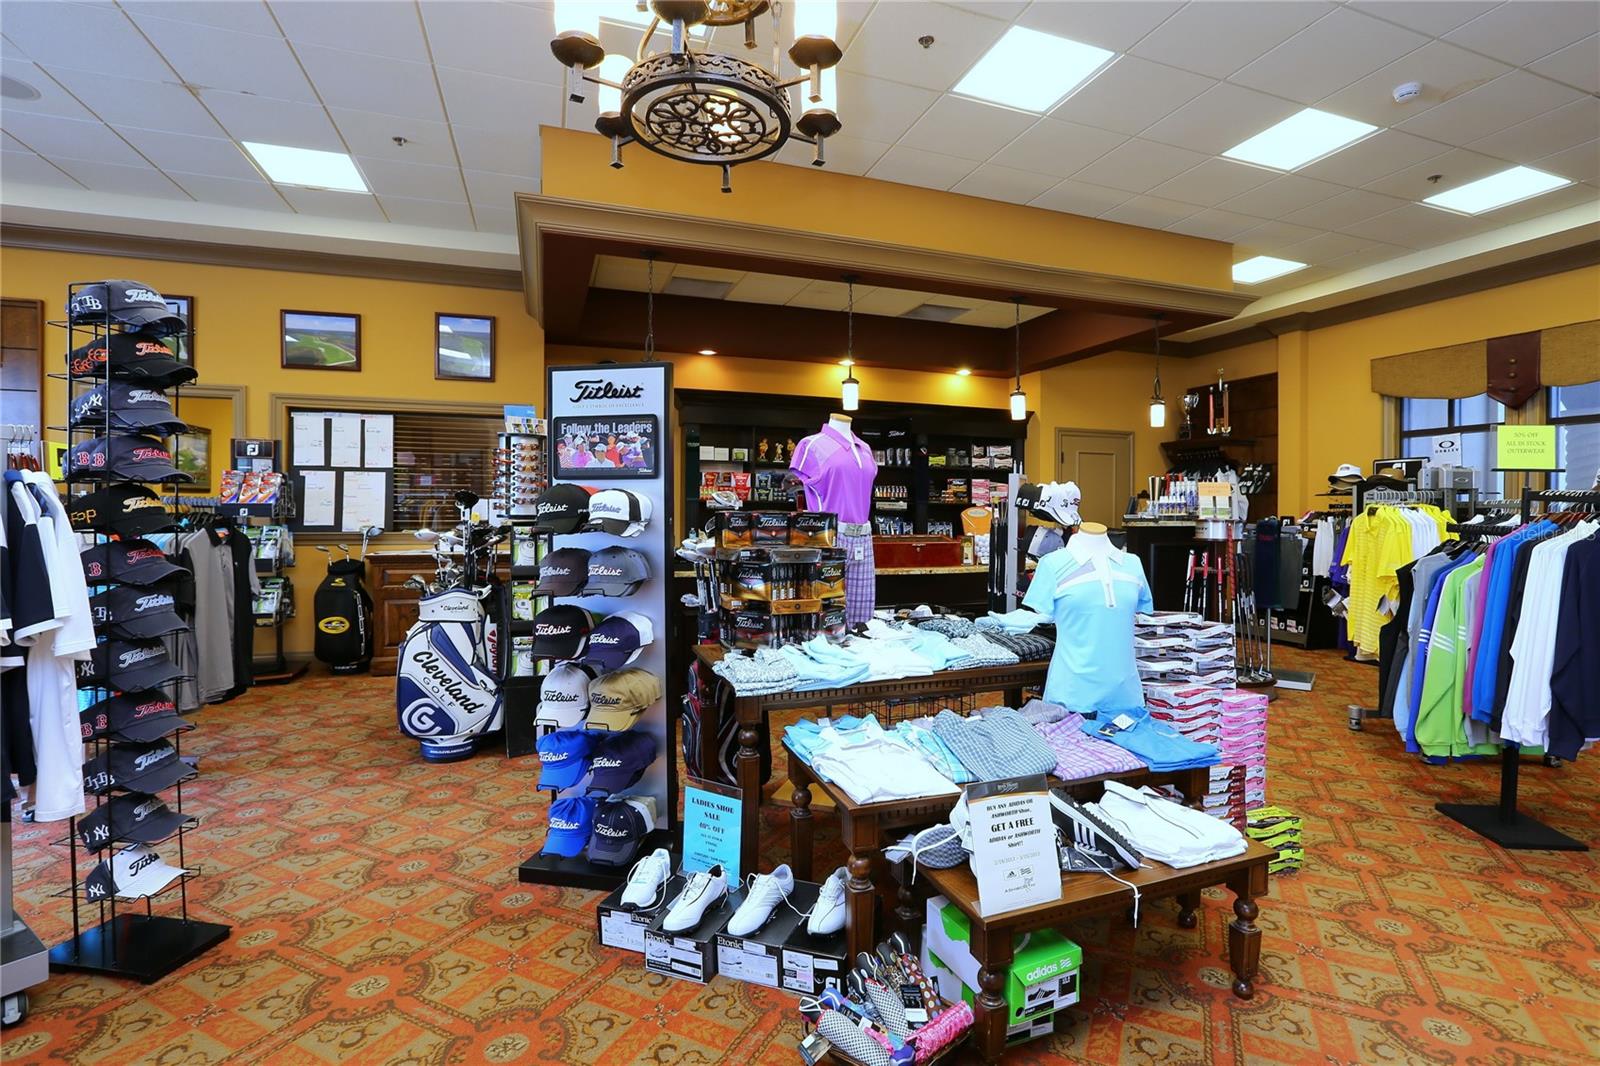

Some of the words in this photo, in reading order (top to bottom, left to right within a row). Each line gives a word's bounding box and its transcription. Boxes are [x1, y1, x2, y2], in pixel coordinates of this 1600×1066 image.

[569, 379, 644, 403] Titleist
[561, 423, 592, 434] Follow
[594, 423, 609, 434] the
[612, 422, 653, 434] Leaders
[758, 518, 787, 527] Titleist
[588, 564, 622, 576] Titleist
[535, 624, 572, 635] Titleist
[589, 633, 620, 644] Titleist
[413, 651, 485, 714] Cleveland
[422, 676, 456, 708] GOLF
[544, 690, 579, 701] Titleist
[591, 693, 621, 704] Titleist
[538, 751, 568, 762] Titleist
[592, 757, 621, 768] Titleist
[692, 797, 715, 808] LADIES
[716, 803, 734, 814] SHOE
[704, 812, 720, 821] SALE
[550, 817, 580, 829] Titleist
[991, 822, 1005, 832] GET
[1009, 821, 1014, 829] A
[1015, 817, 1034, 828] FREE
[595, 824, 628, 837] Titleist
[713, 826, 725, 834] OFF
[631, 912, 652, 924] Etonic
[717, 936, 743, 949] Etonic
[1027, 963, 1057, 981] adidas
